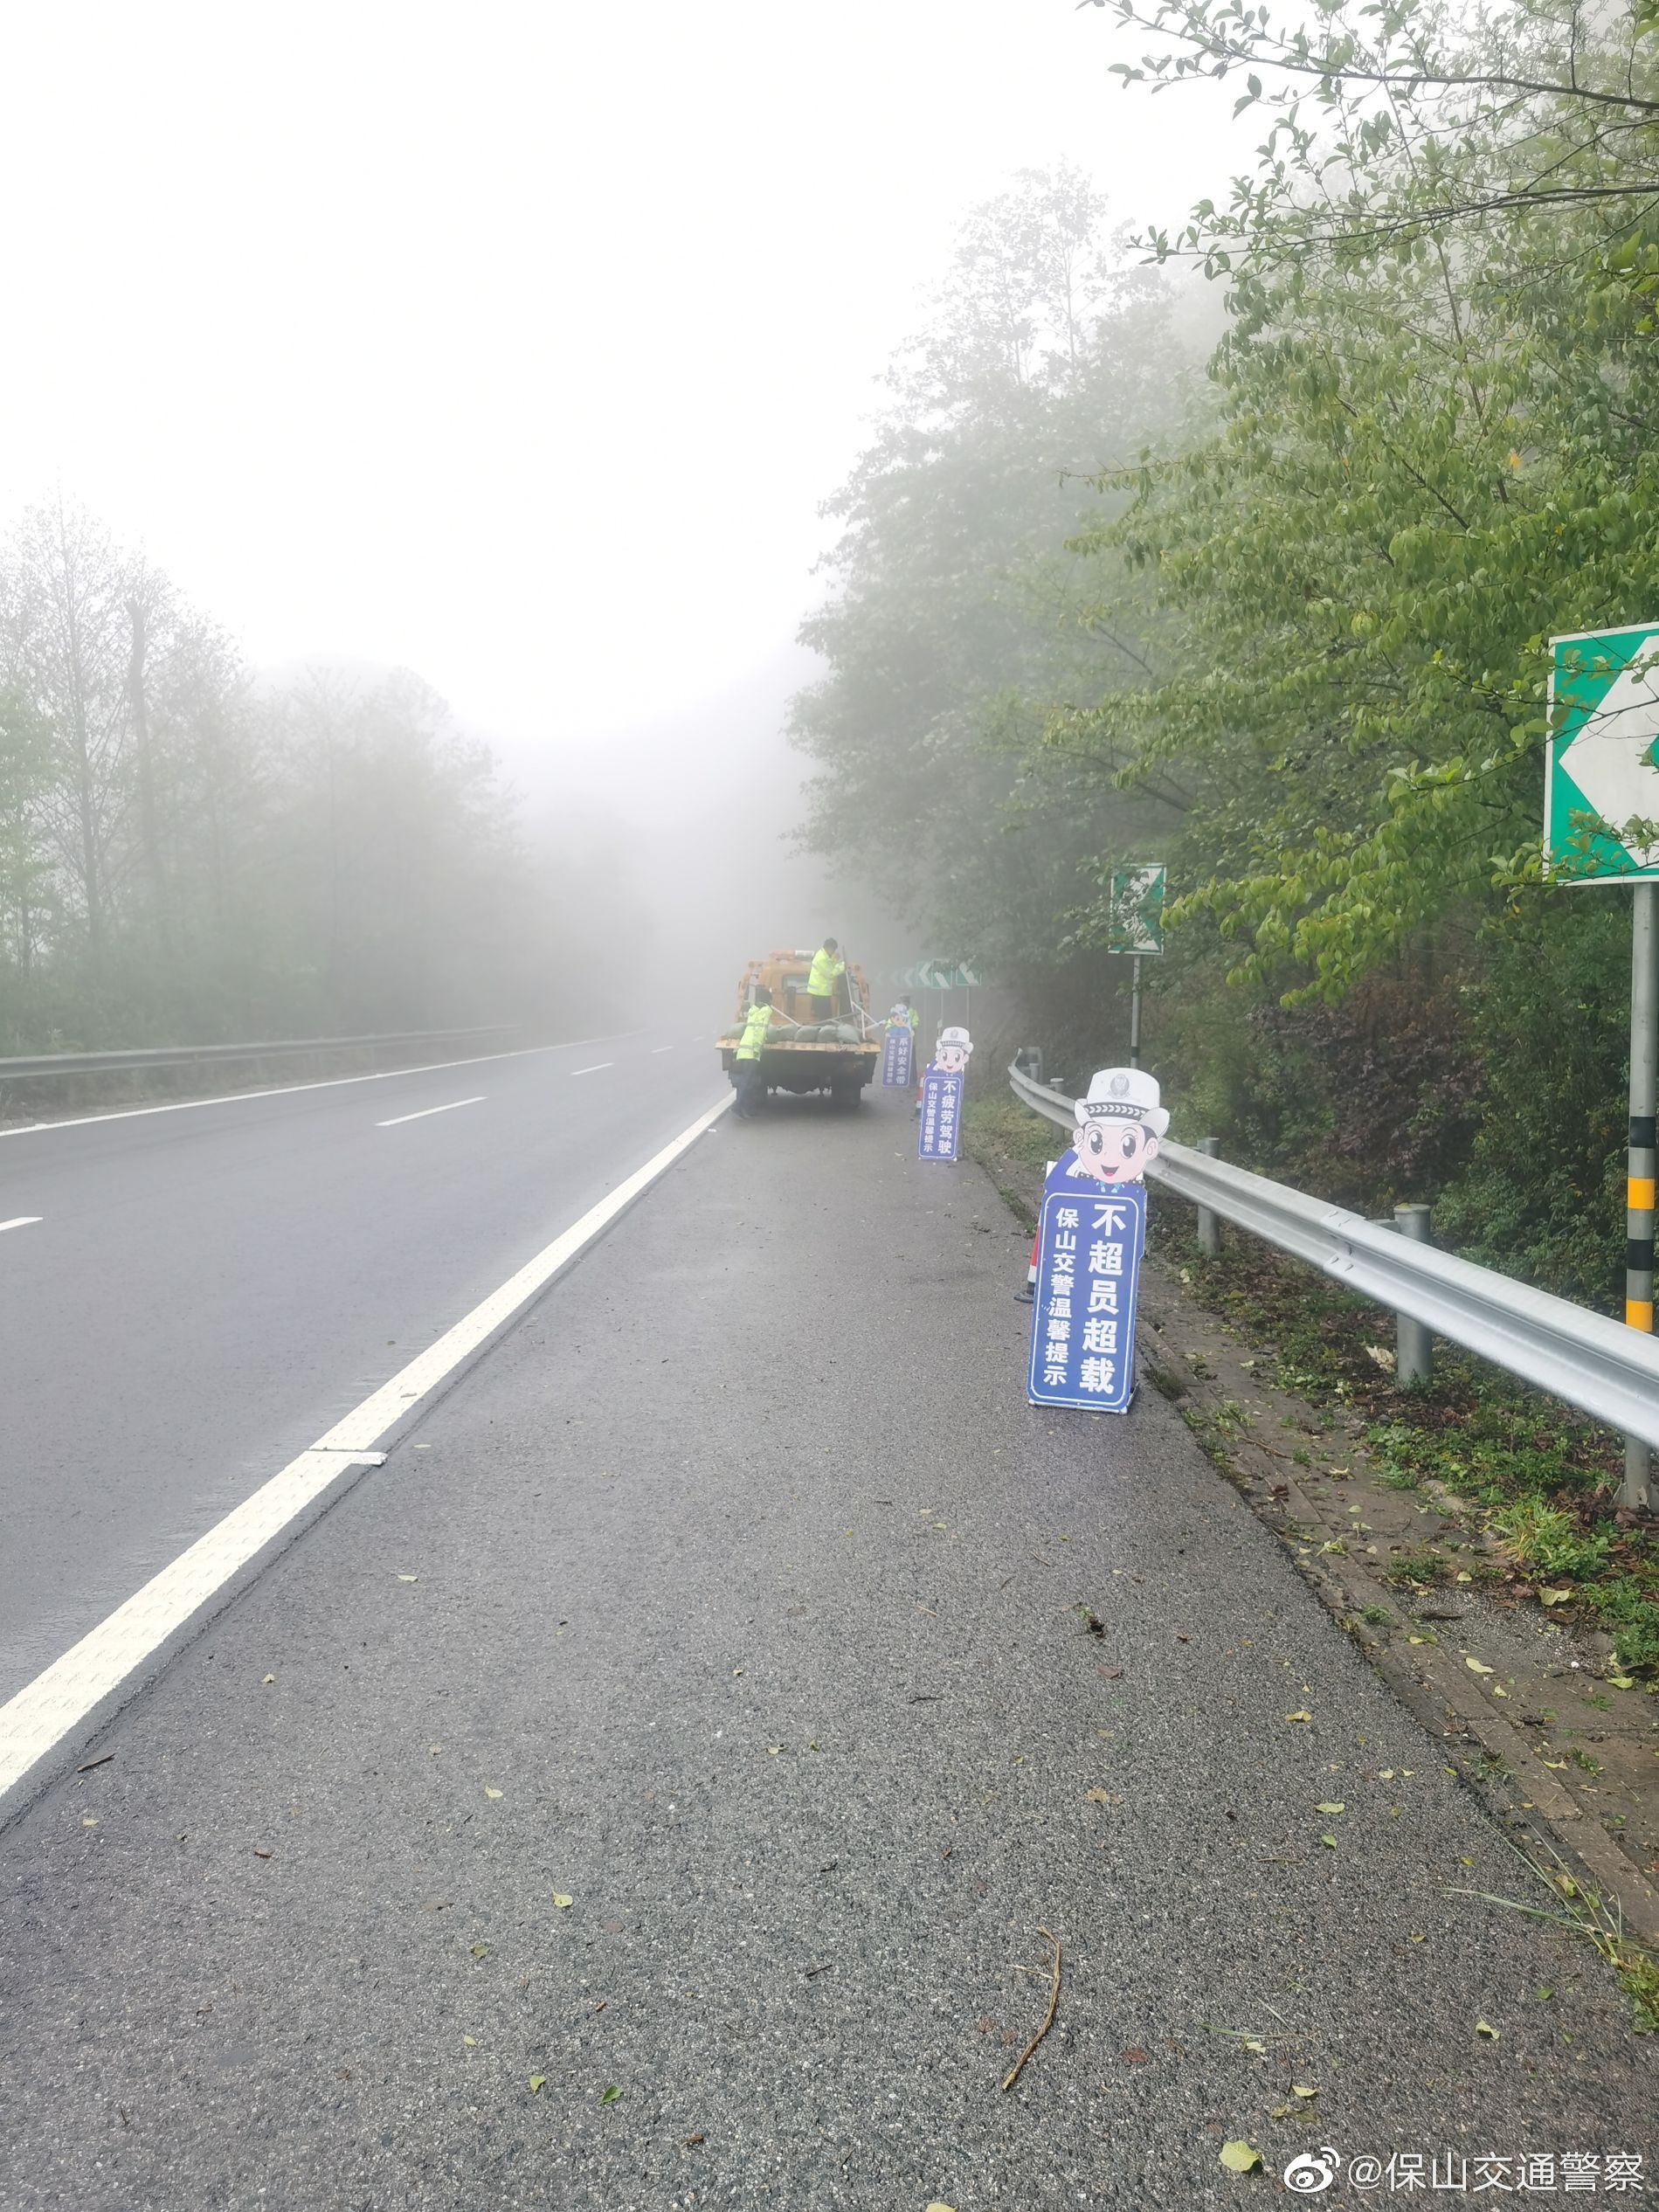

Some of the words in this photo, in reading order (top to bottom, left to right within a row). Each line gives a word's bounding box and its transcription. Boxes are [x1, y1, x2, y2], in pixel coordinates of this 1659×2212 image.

[937, 1080, 957, 1154] 不疲劳驾驶
[1043, 1207, 1079, 1386] 保山交警温馨提示
[1080, 1204, 1126, 1394] 不超员超载
